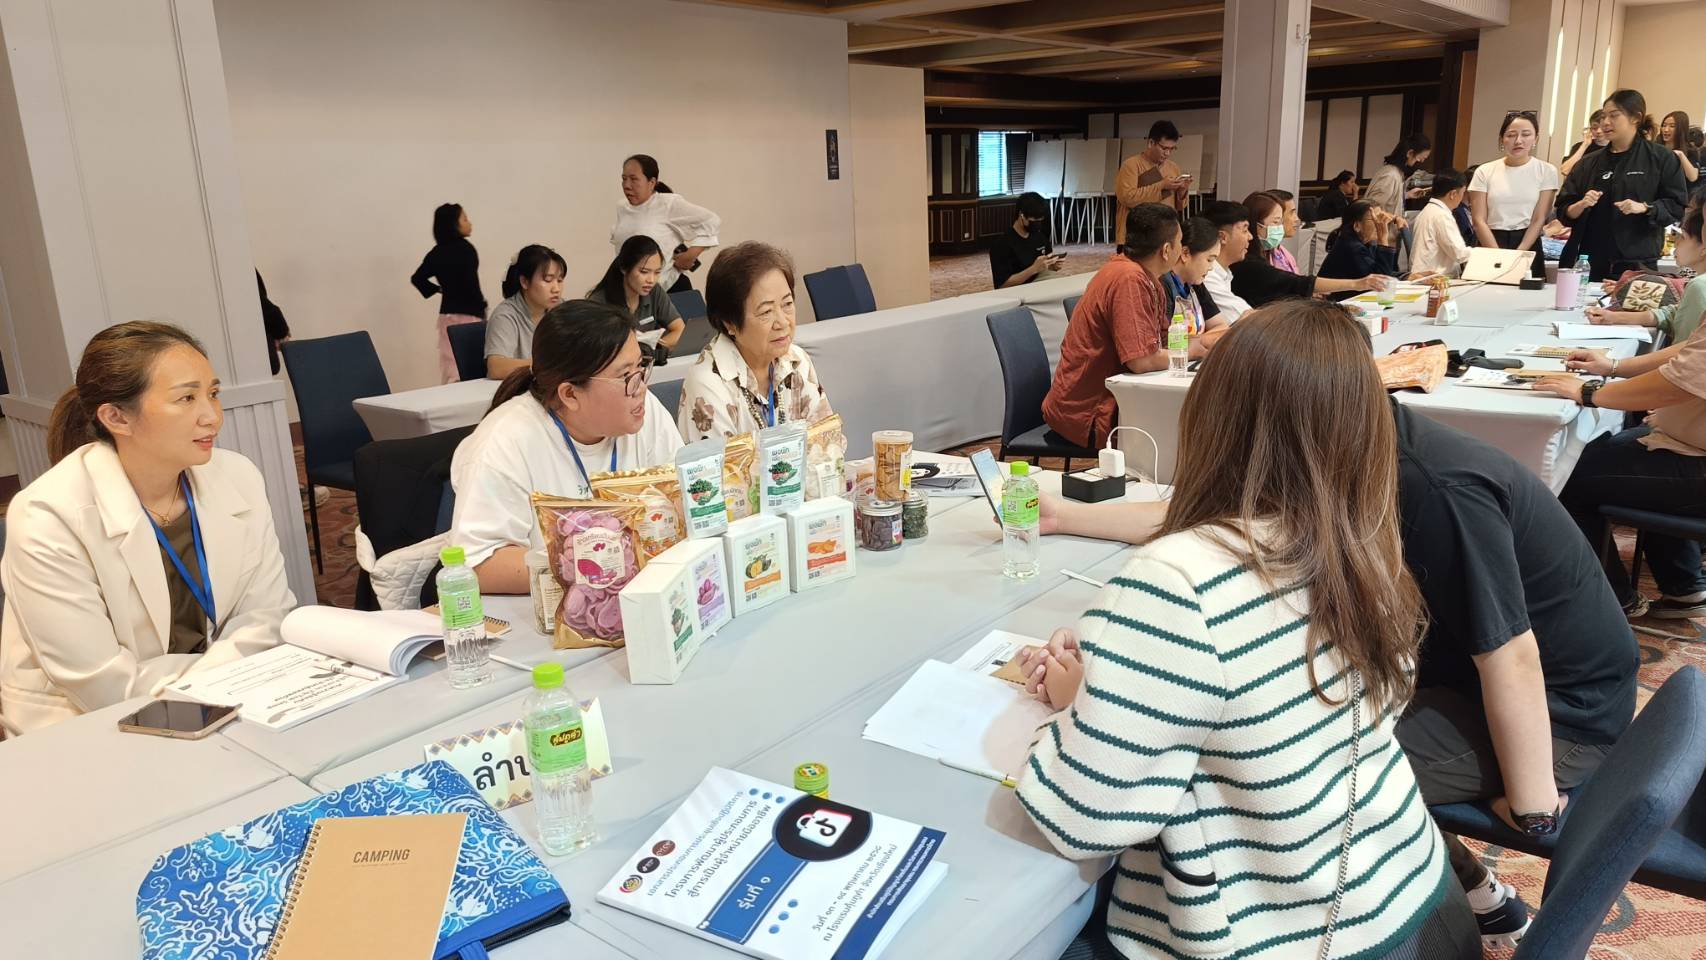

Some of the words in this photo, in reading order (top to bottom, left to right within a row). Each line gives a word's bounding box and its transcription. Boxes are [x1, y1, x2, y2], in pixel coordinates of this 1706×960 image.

[353, 848, 410, 864] CAMPING
[664, 801, 757, 898] โครงการพัฒนาผู้ประกอบการ
[688, 805, 771, 897] สู่การเป็นผู้จำหน่ายมืออาชีพ
[737, 884, 763, 909] รุ่นที่
[812, 916, 827, 931] วันที่
[824, 933, 832, 941] ณ
